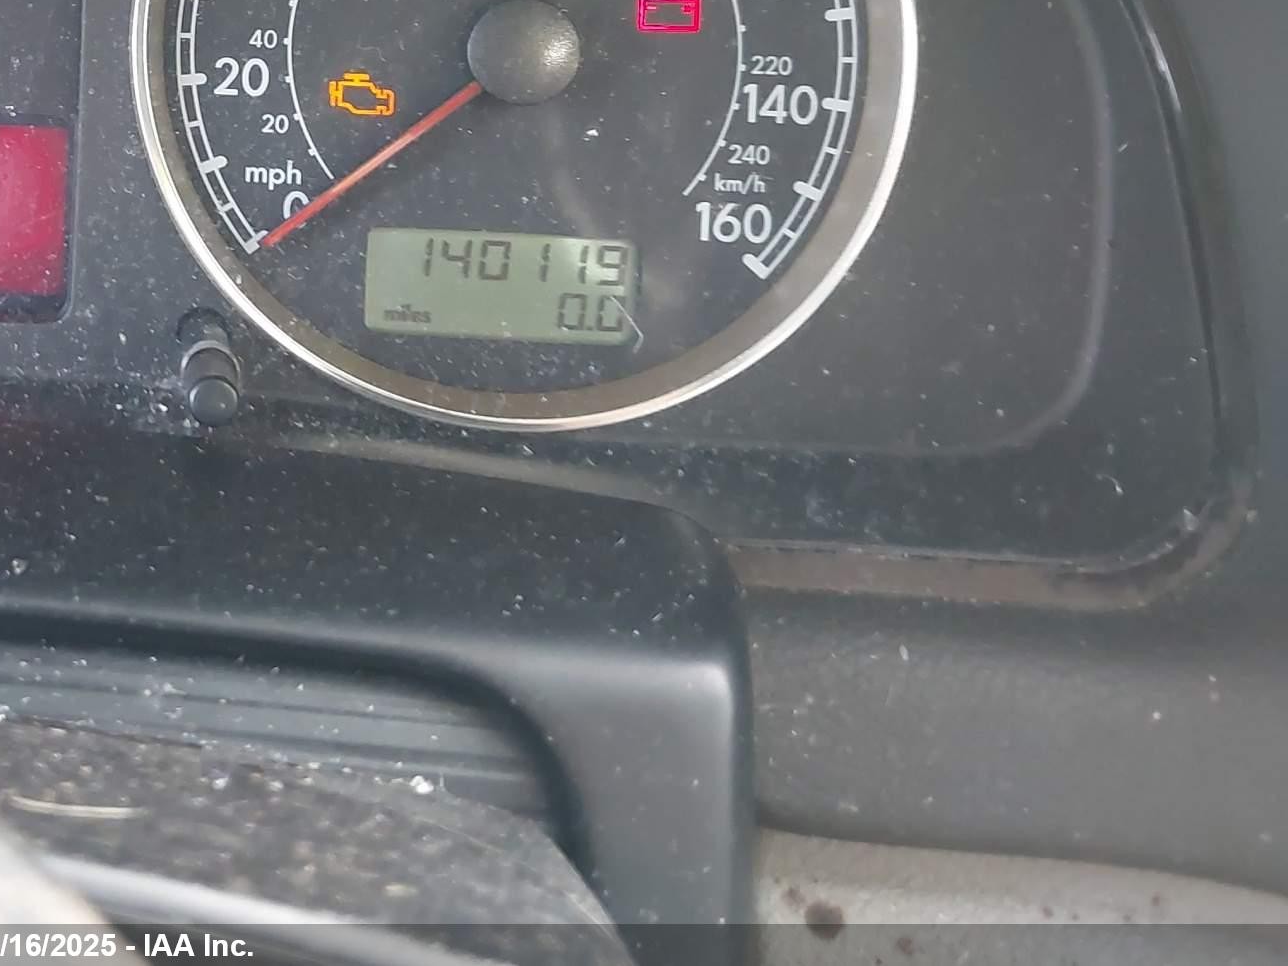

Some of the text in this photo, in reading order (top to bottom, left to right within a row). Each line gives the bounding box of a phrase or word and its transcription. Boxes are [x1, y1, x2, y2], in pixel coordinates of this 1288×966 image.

[249, 30, 278, 50] 40
[214, 58, 270, 96] 20
[751, 57, 792, 76] 220
[744, 85, 817, 124] 140
[262, 115, 290, 135] 20
[728, 145, 770, 165] 240
[245, 162, 302, 191] mph
[714, 172, 766, 194] km/h
[695, 204, 773, 245] 160
[422, 240, 626, 286] 140119
[558, 293, 624, 332] 0.0
